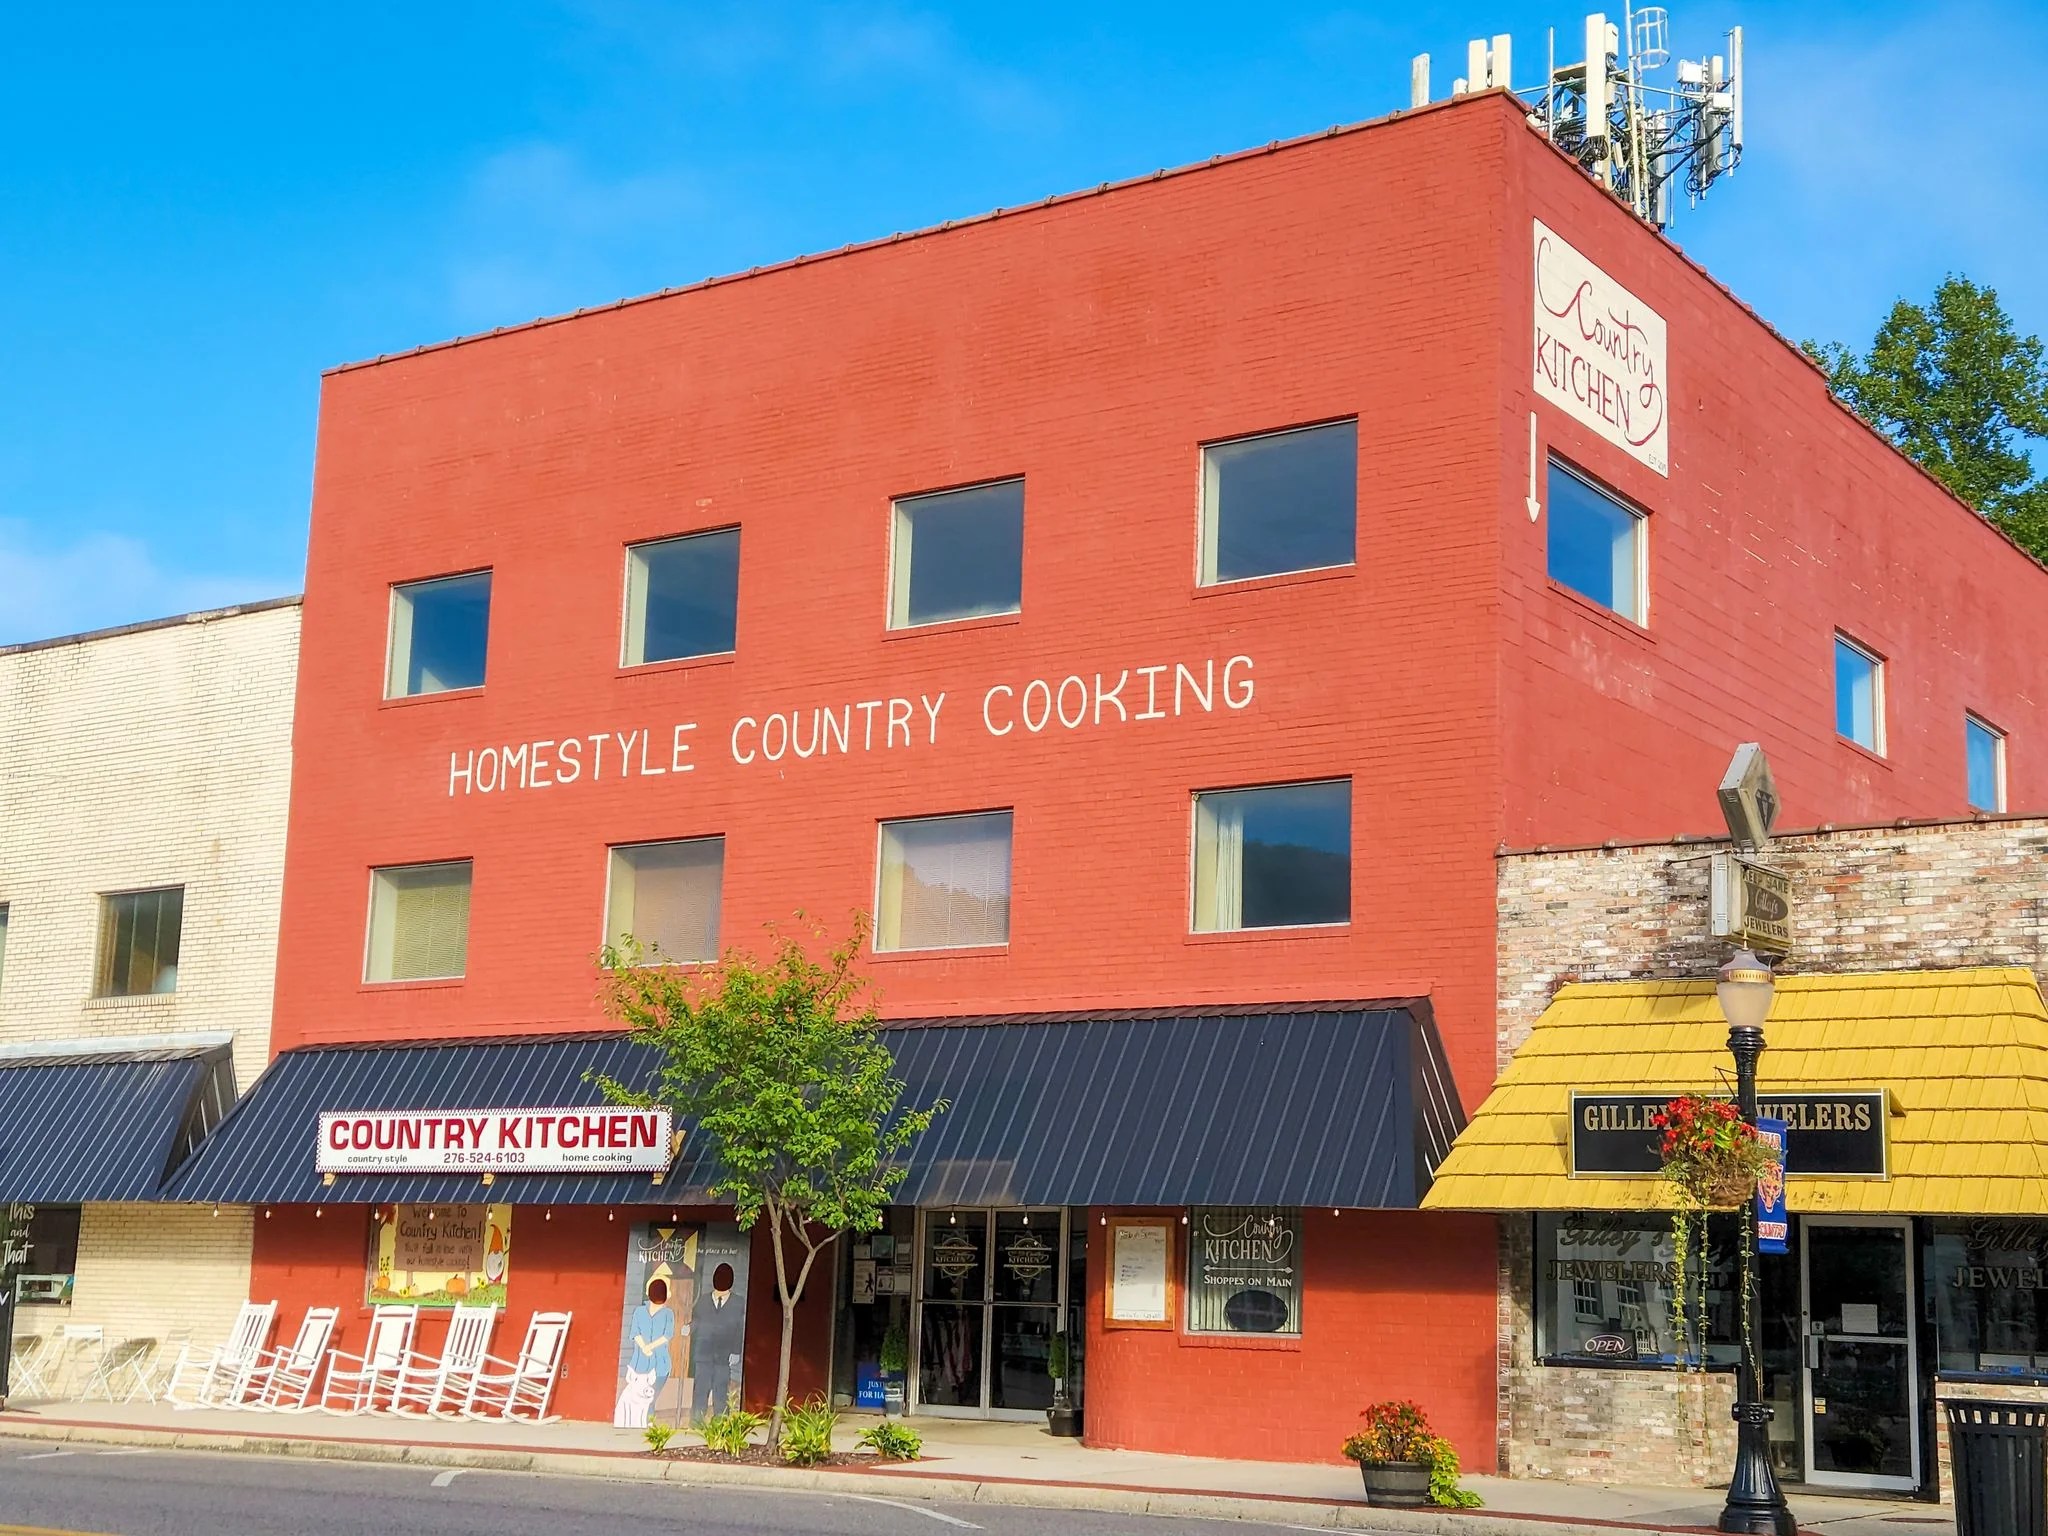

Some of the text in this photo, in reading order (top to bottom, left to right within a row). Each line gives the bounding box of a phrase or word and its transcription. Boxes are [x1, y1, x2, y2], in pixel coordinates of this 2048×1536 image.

[1537, 236, 1663, 446] Country
[1536, 326, 1632, 434] KITCHEN
[448, 655, 1254, 797] HOMESTYLE COUNTRY COOKING
[1744, 916, 1789, 938] JEWELERS
[1757, 1103, 1872, 1131] WELERS
[329, 1114, 658, 1150] COUNTRY KITCHEN
[347, 1152, 633, 1164] country style 276-524-6103 home cooking
[413, 1205, 452, 1218] Welome
[10, 1224, 30, 1238] and
[400, 1220, 482, 1243] Country Kitchen!
[1203, 1214, 1294, 1264] Country
[3, 1240, 35, 1271] That
[639, 1250, 675, 1264] KITCHEN
[1205, 1239, 1272, 1264] KITCHEN
[1204, 1274, 1293, 1287] SHOPPES ON MAIN
[1546, 1259, 1680, 1283] JEWELERS
[1585, 1338, 1625, 1351] OPEN
[858, 1390, 873, 1399] FOR
